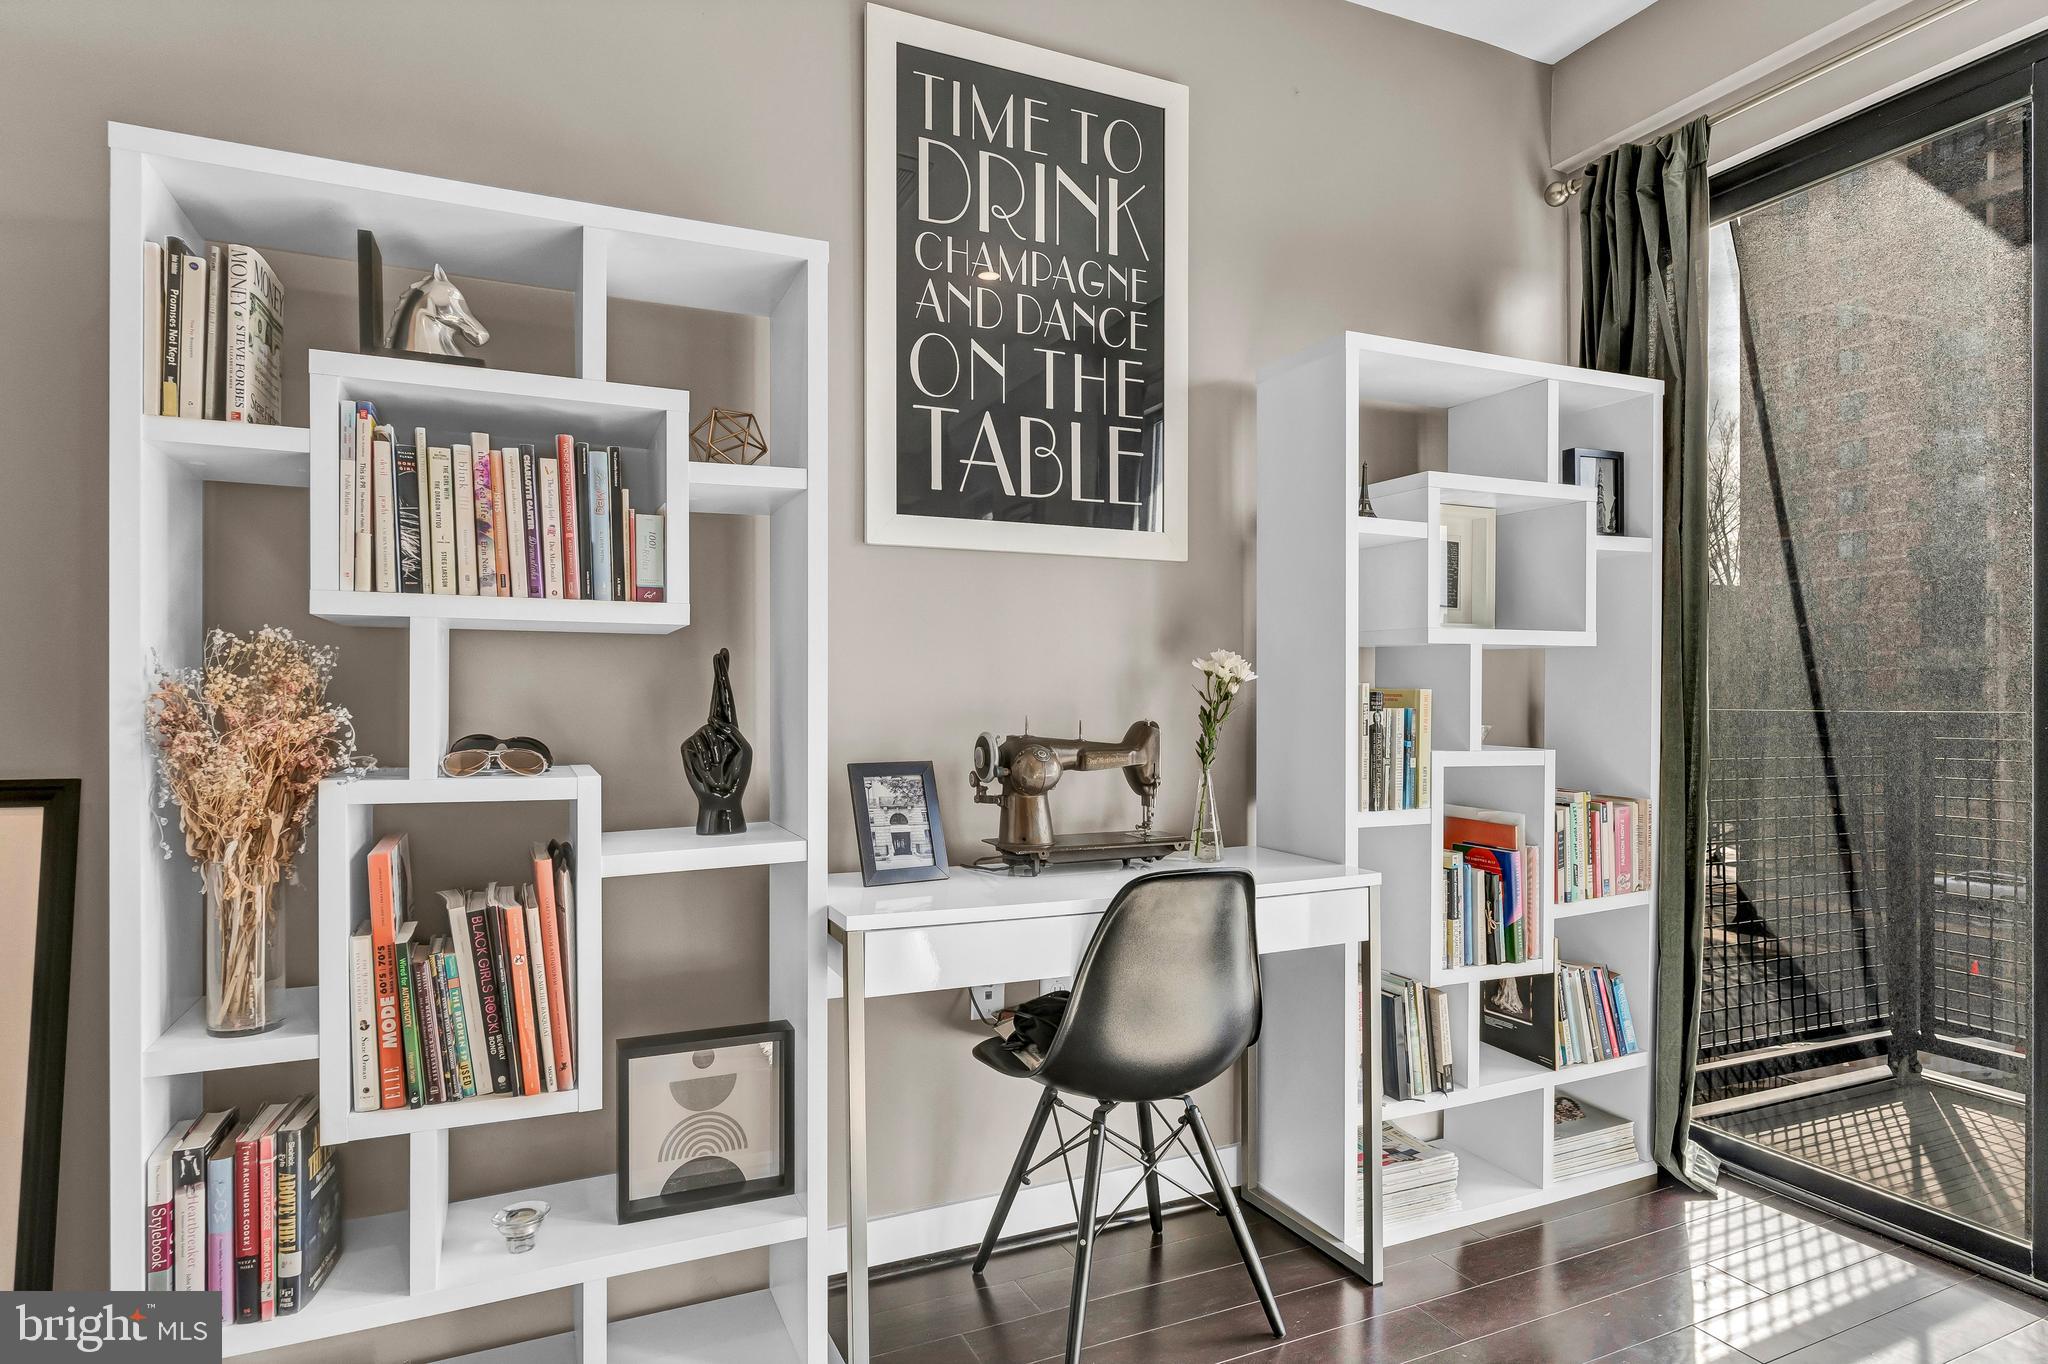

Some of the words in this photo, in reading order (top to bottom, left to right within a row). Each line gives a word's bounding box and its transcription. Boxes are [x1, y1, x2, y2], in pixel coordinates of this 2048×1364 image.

[913, 70, 1049, 156] TIME
[1071, 108, 1142, 174] TO
[918, 136, 1149, 261] DRINK
[230, 250, 248, 311] MONEY
[914, 231, 1148, 305] CHAMPAGNE
[253, 260, 285, 318] MONEY
[169, 289, 179, 327] Promises
[915, 278, 1003, 329] AND
[1017, 293, 1148, 351] DANCE
[169, 329, 179, 345] Not
[236, 325, 247, 361] STEVE
[166, 347, 178, 366] Kept
[234, 363, 245, 409] FORBES
[910, 332, 1005, 404] ON
[1033, 348, 1145, 419] THE
[478, 451, 487, 466] the
[562, 443, 570, 462] WORD
[563, 463, 571, 472] OF
[912, 404, 1144, 506] TABLE
[360, 463, 368, 474] This
[458, 461, 468, 489] blink
[475, 468, 488, 499] perfect
[523, 454, 534, 499] CHARLOTTE
[360, 481, 368, 489] PR
[564, 474, 572, 495] MOUTH
[480, 502, 490, 519] life
[526, 500, 536, 530] CARTER
[565, 496, 574, 531] MARKETING
[480, 541, 489, 556] Erin
[648, 531, 656, 549] 1001
[481, 557, 491, 582] Noelle
[471, 915, 487, 955] BLACK
[377, 946, 386, 967] 70'S
[399, 958, 407, 977] Wired
[379, 973, 388, 994] 60'S
[400, 977, 408, 986] for
[478, 958, 493, 993] GIRLS
[401, 986, 412, 1028] AUTHENTICITY
[452, 989, 461, 1007] THE
[380, 996, 397, 1049] MODE
[455, 1011, 466, 1047] BROKEN
[484, 996, 501, 1034] ROCK!
[361, 1036, 369, 1053] Suze
[425, 1005, 433, 1030] MEANING
[429, 1040, 438, 1082] SUNGLASSES
[489, 1036, 497, 1055] BOND
[495, 1034, 506, 1061] BEVERLY
[362, 1054, 370, 1080] Orman
[383, 1066, 401, 1099] ELLE
[460, 1064, 472, 1086] USED
[287, 1141, 296, 1166] Skolnick
[263, 1165, 272, 1196] WOMEN'S
[278, 1172, 297, 1215] ABOVE
[263, 1197, 272, 1231] LACROSSE
[147, 1207, 167, 1269] Stylebook
[186, 1195, 201, 1268] Heartbreaker
[278, 1216, 297, 1244] THE
